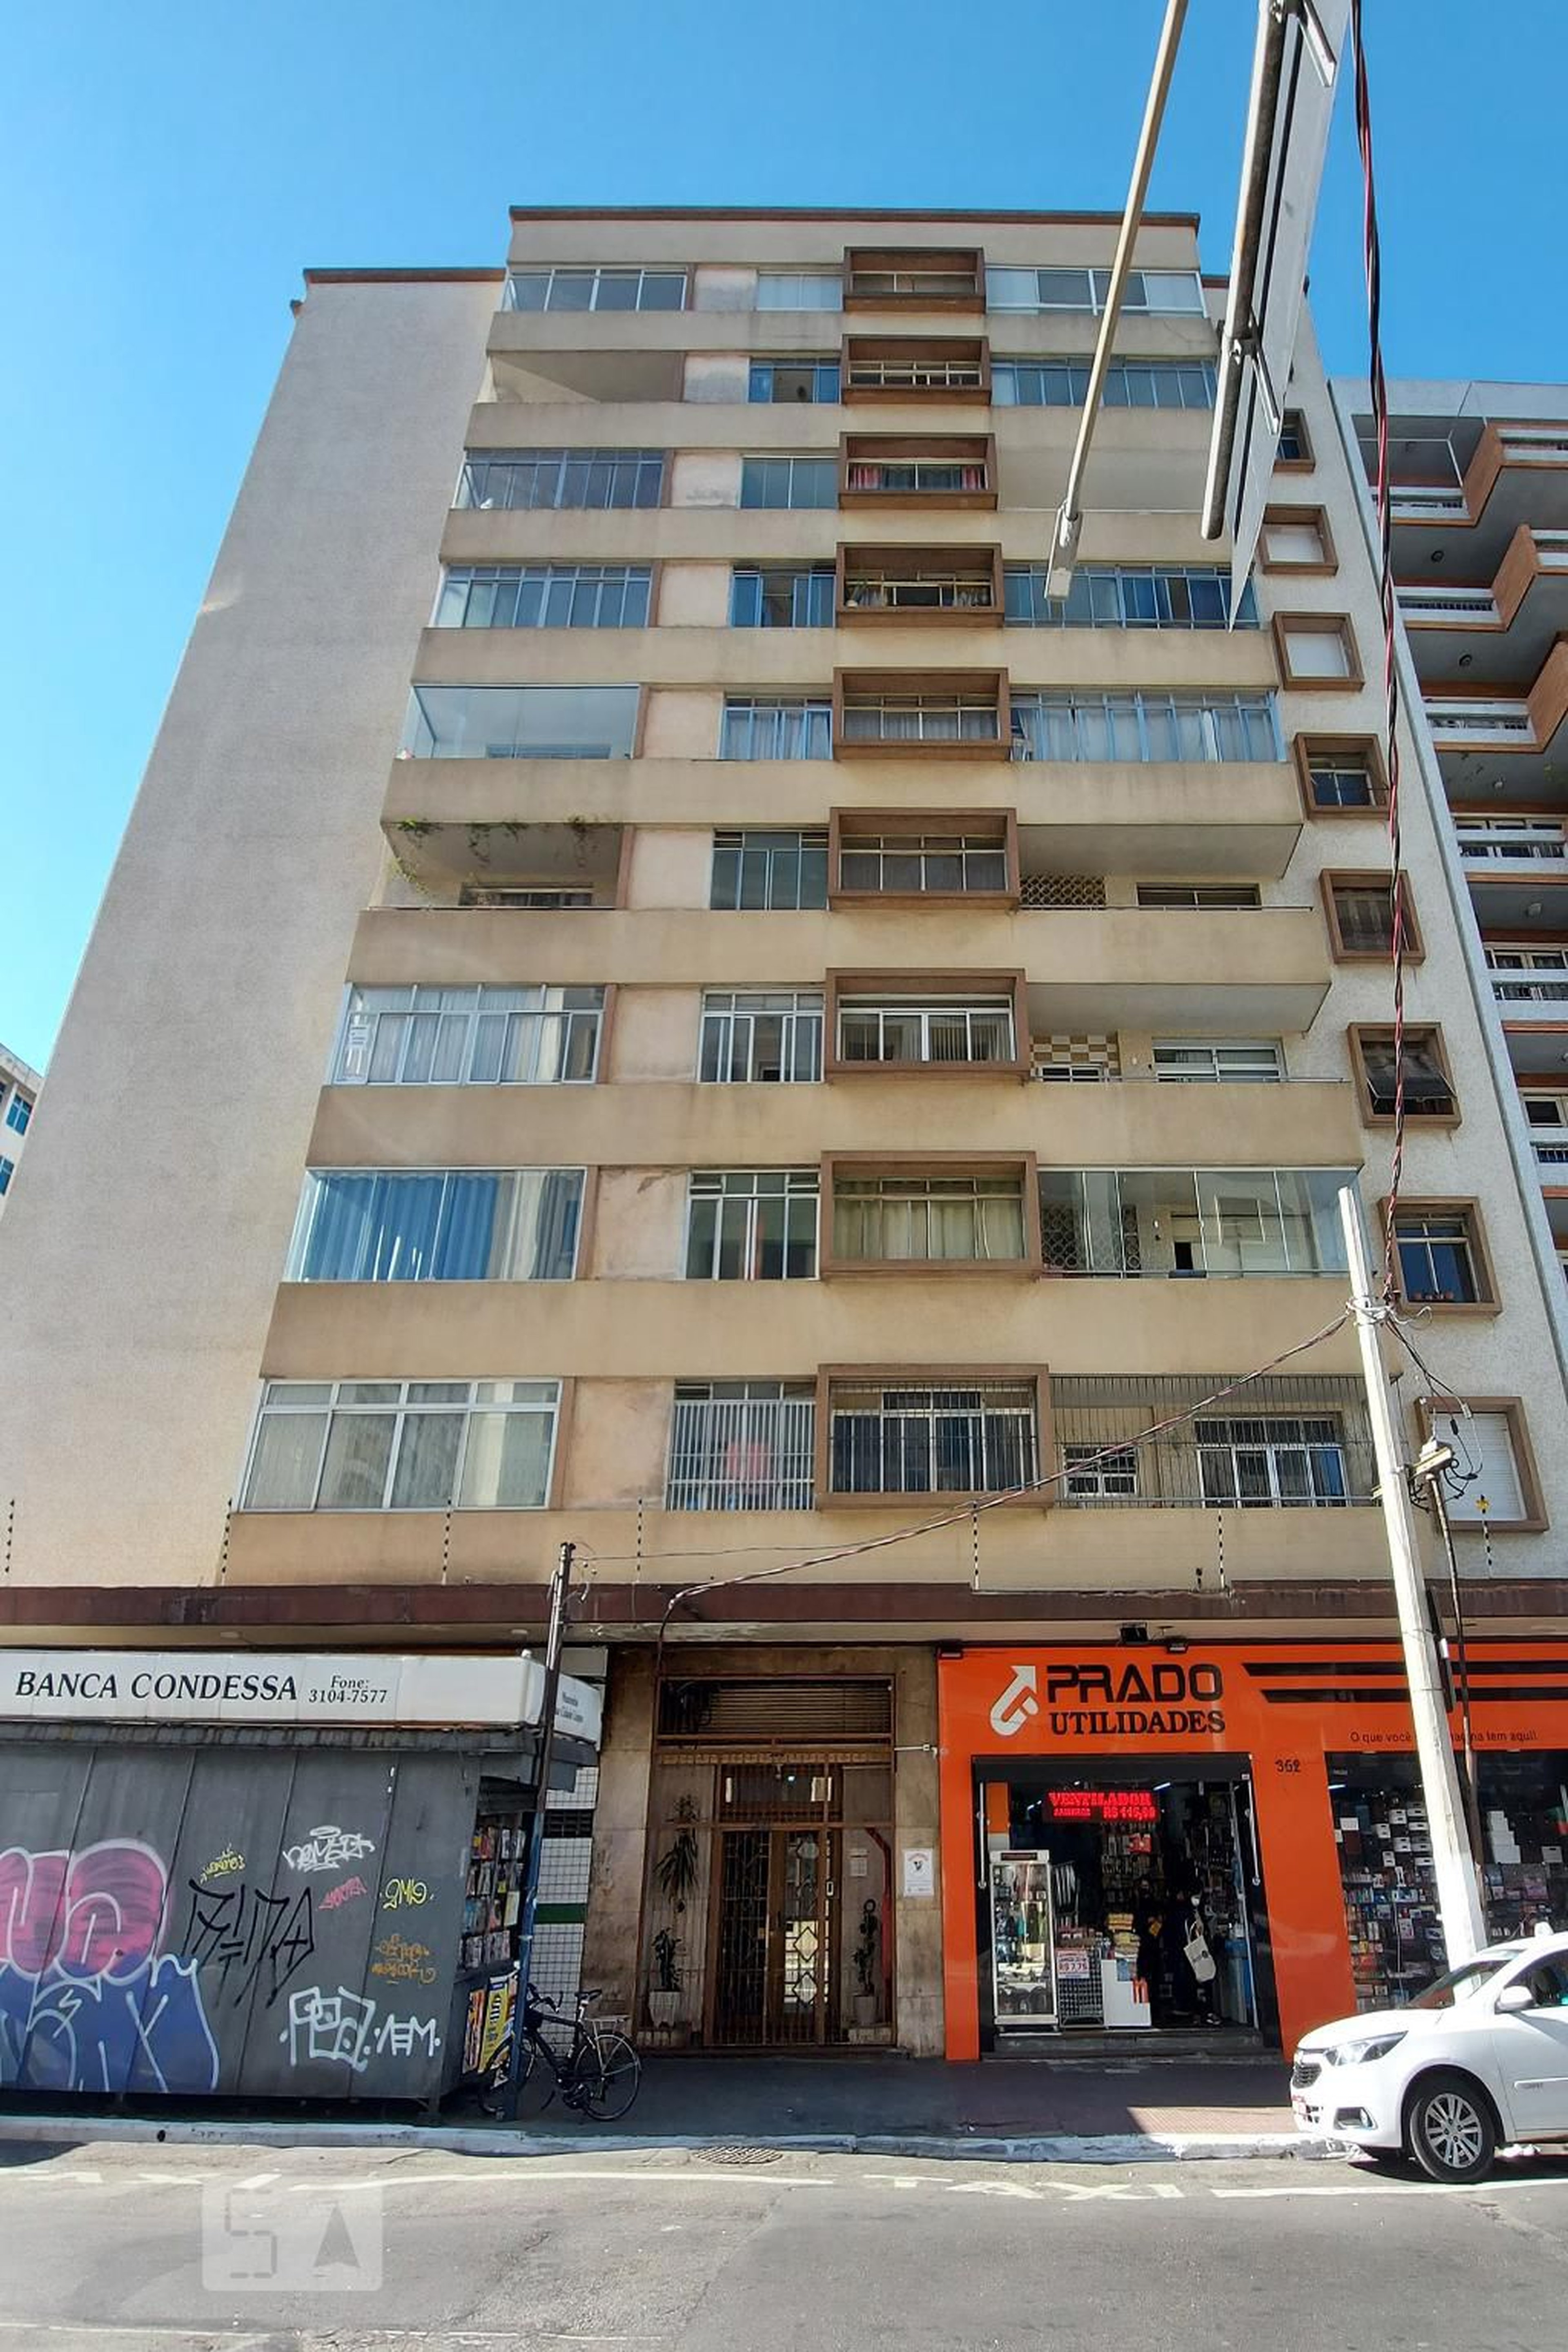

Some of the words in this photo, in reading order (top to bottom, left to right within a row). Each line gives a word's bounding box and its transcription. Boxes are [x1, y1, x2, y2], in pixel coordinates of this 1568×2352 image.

[16, 1671, 118, 1698] BANCA
[131, 1673, 298, 1700] CONDESSA
[330, 1675, 370, 1688] Fone:
[1047, 1664, 1222, 1703] PRADO
[309, 1689, 388, 1703] 3104-7577
[1049, 1711, 1225, 1735] UTILIDADES
[1350, 1731, 1359, 1742] O
[1362, 1733, 1383, 1744] que
[1486, 1730, 1507, 1741] tem
[1049, 1793, 1151, 1806] VENTILADOR
